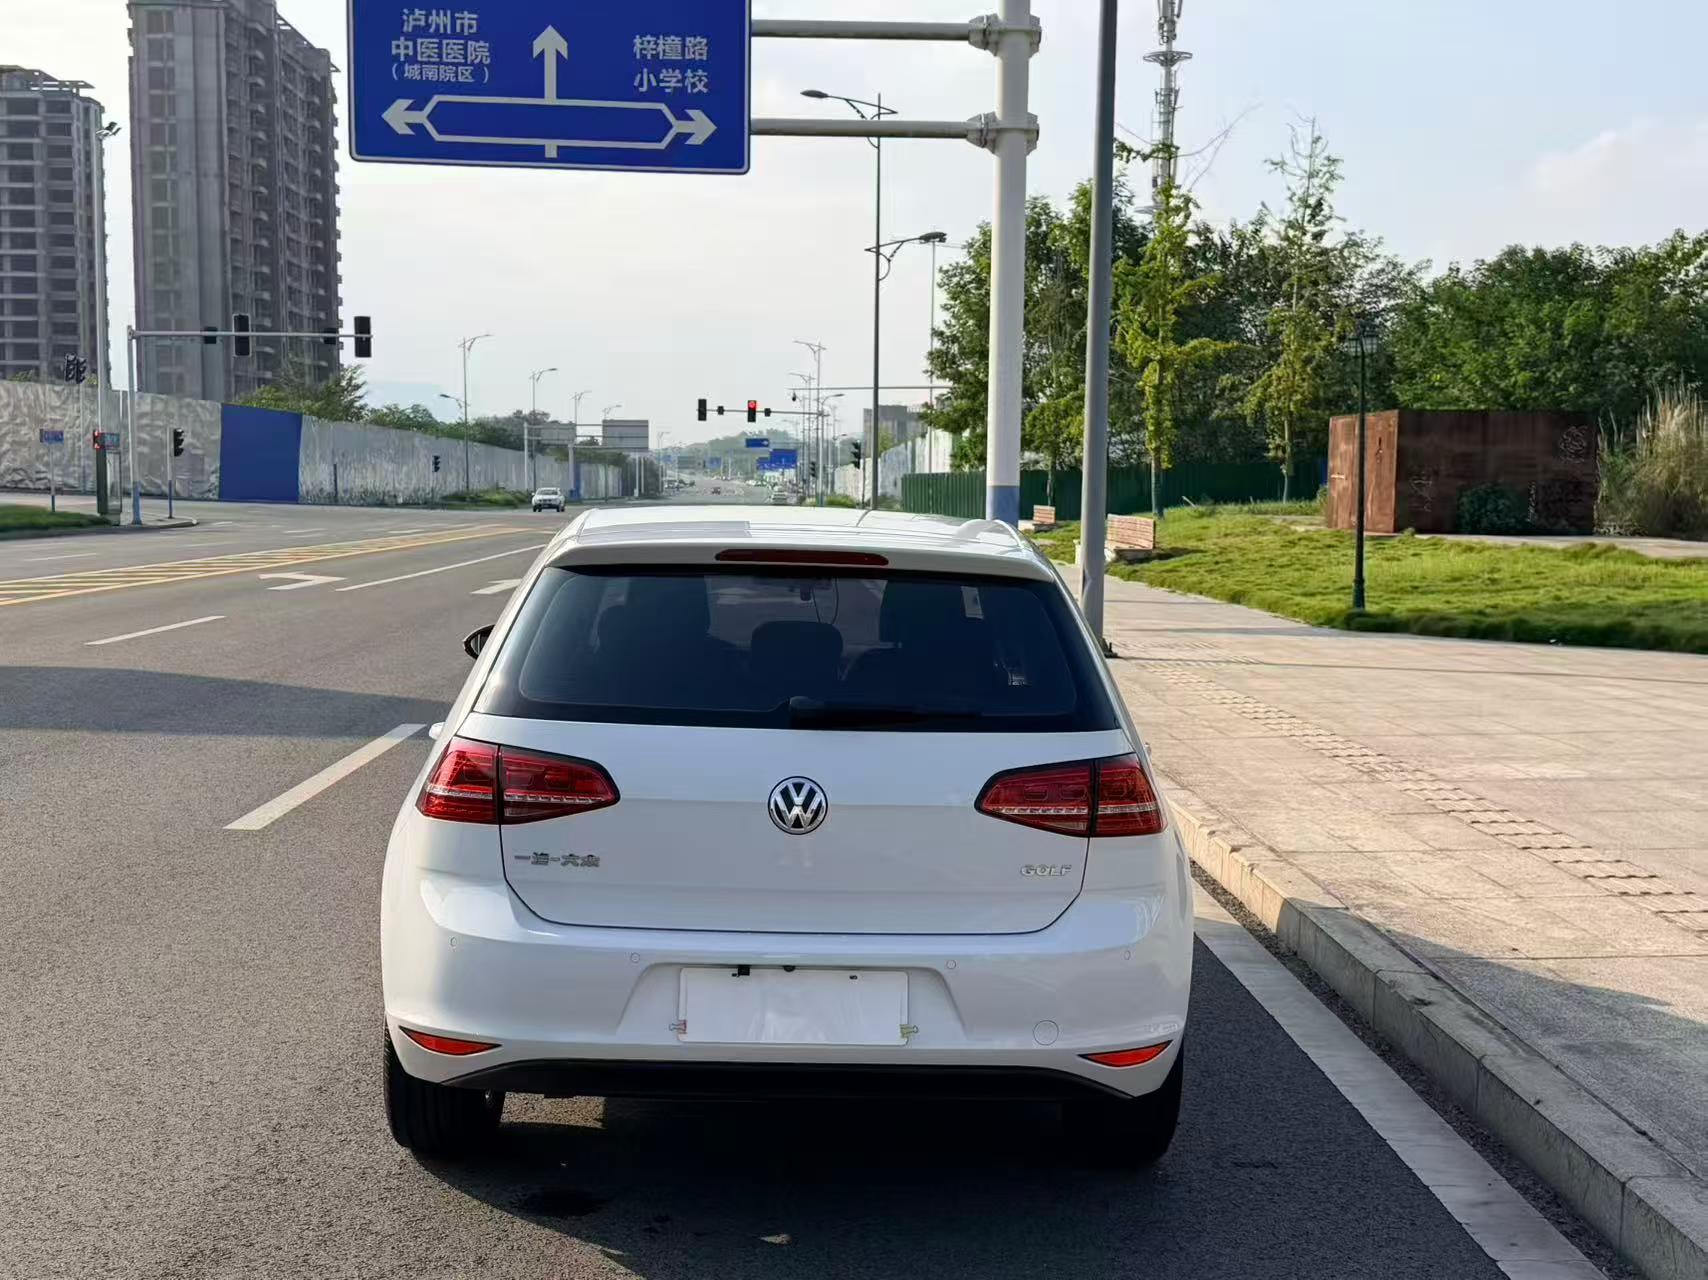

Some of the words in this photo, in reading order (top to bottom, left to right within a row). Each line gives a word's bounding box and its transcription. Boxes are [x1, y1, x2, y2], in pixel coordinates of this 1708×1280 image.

[402, 8, 478, 36] 泸州市
[391, 36, 491, 65] 中医医院
[633, 68, 709, 93] 小学校
[1021, 864, 1072, 877] GOLF
